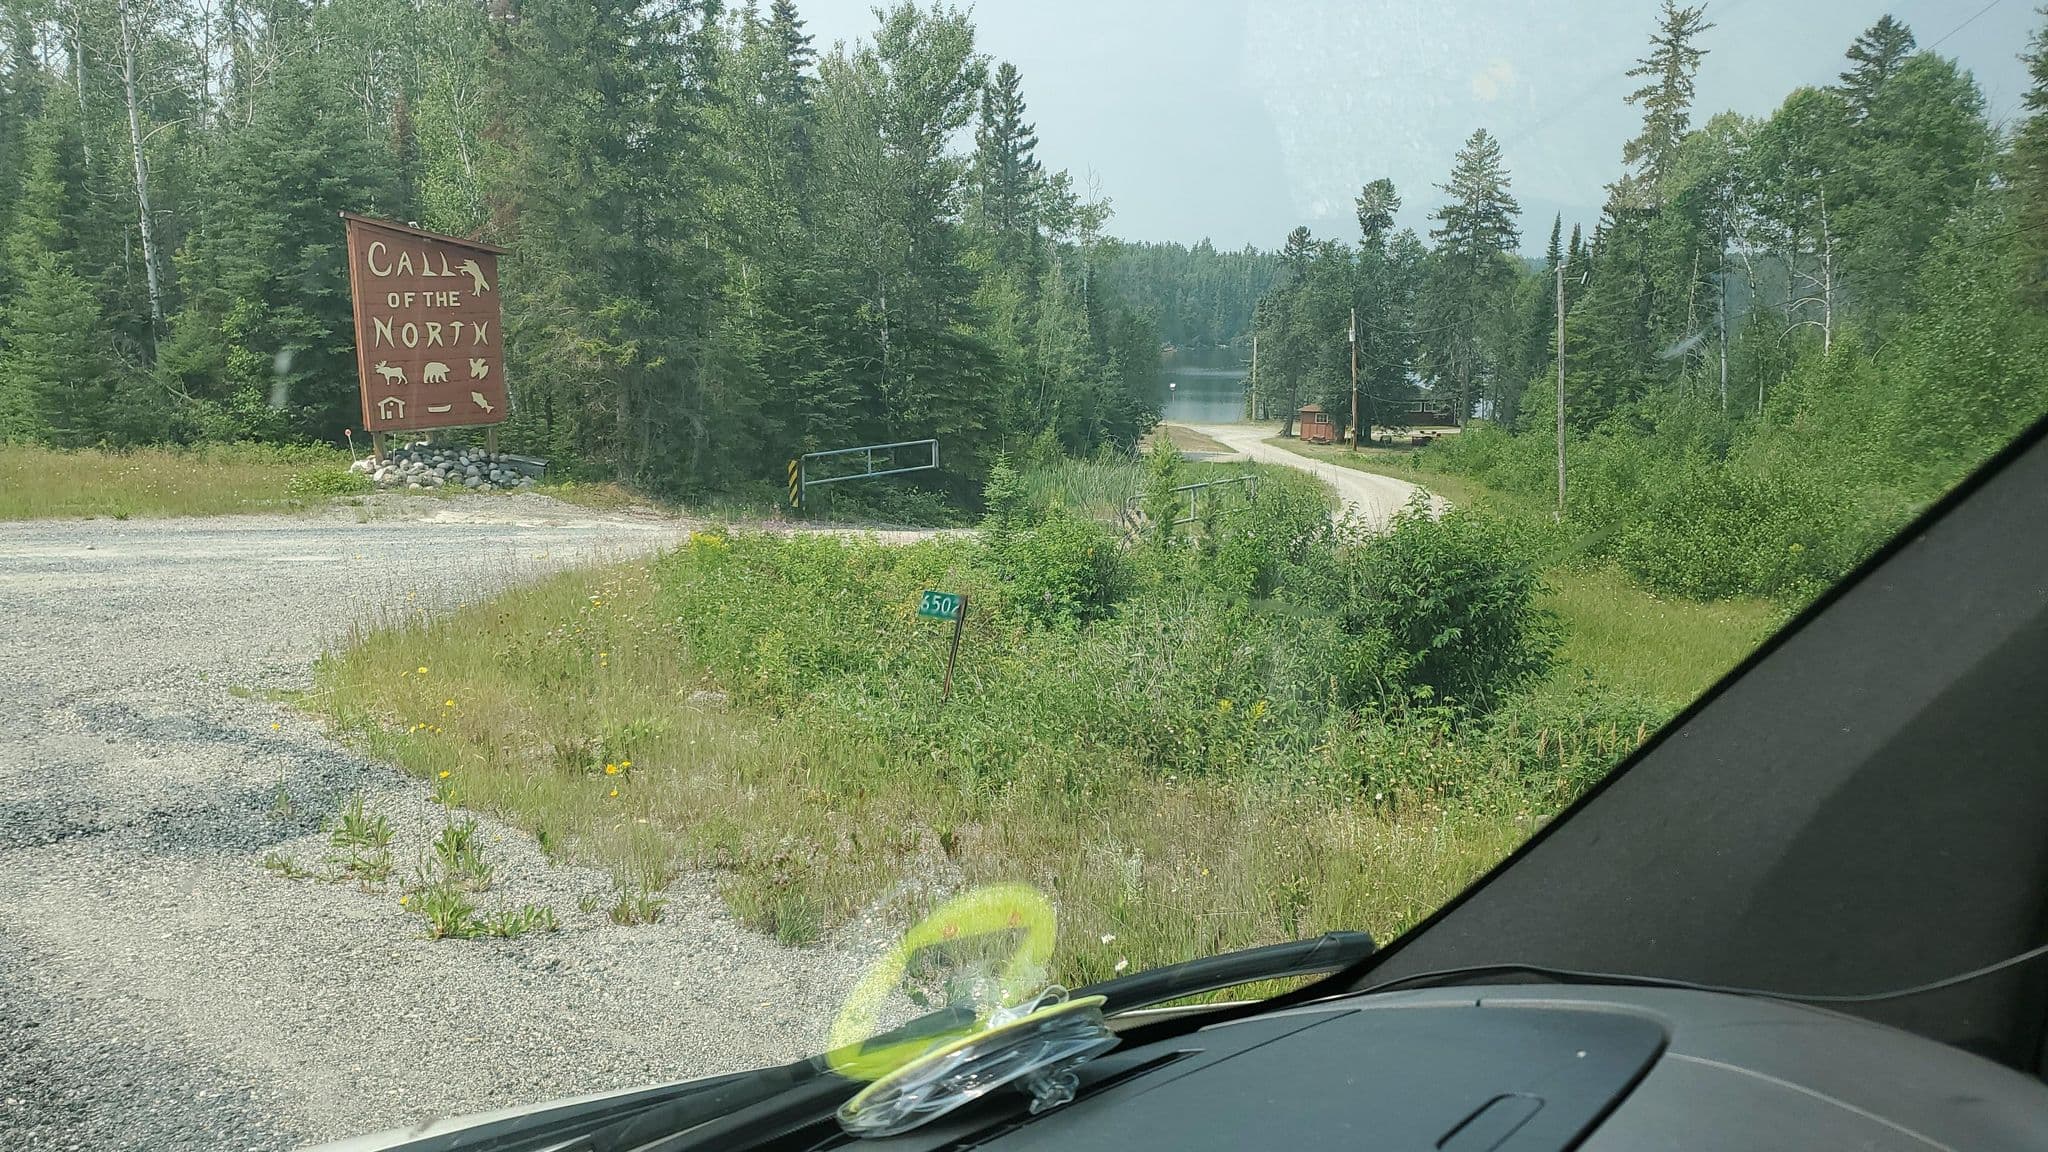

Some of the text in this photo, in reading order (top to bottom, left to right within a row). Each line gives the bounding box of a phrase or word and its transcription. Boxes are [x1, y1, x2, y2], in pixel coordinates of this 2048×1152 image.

[368, 241, 457, 277] CALL
[387, 291, 461, 308] OF THE
[373, 315, 489, 348] NORTH
